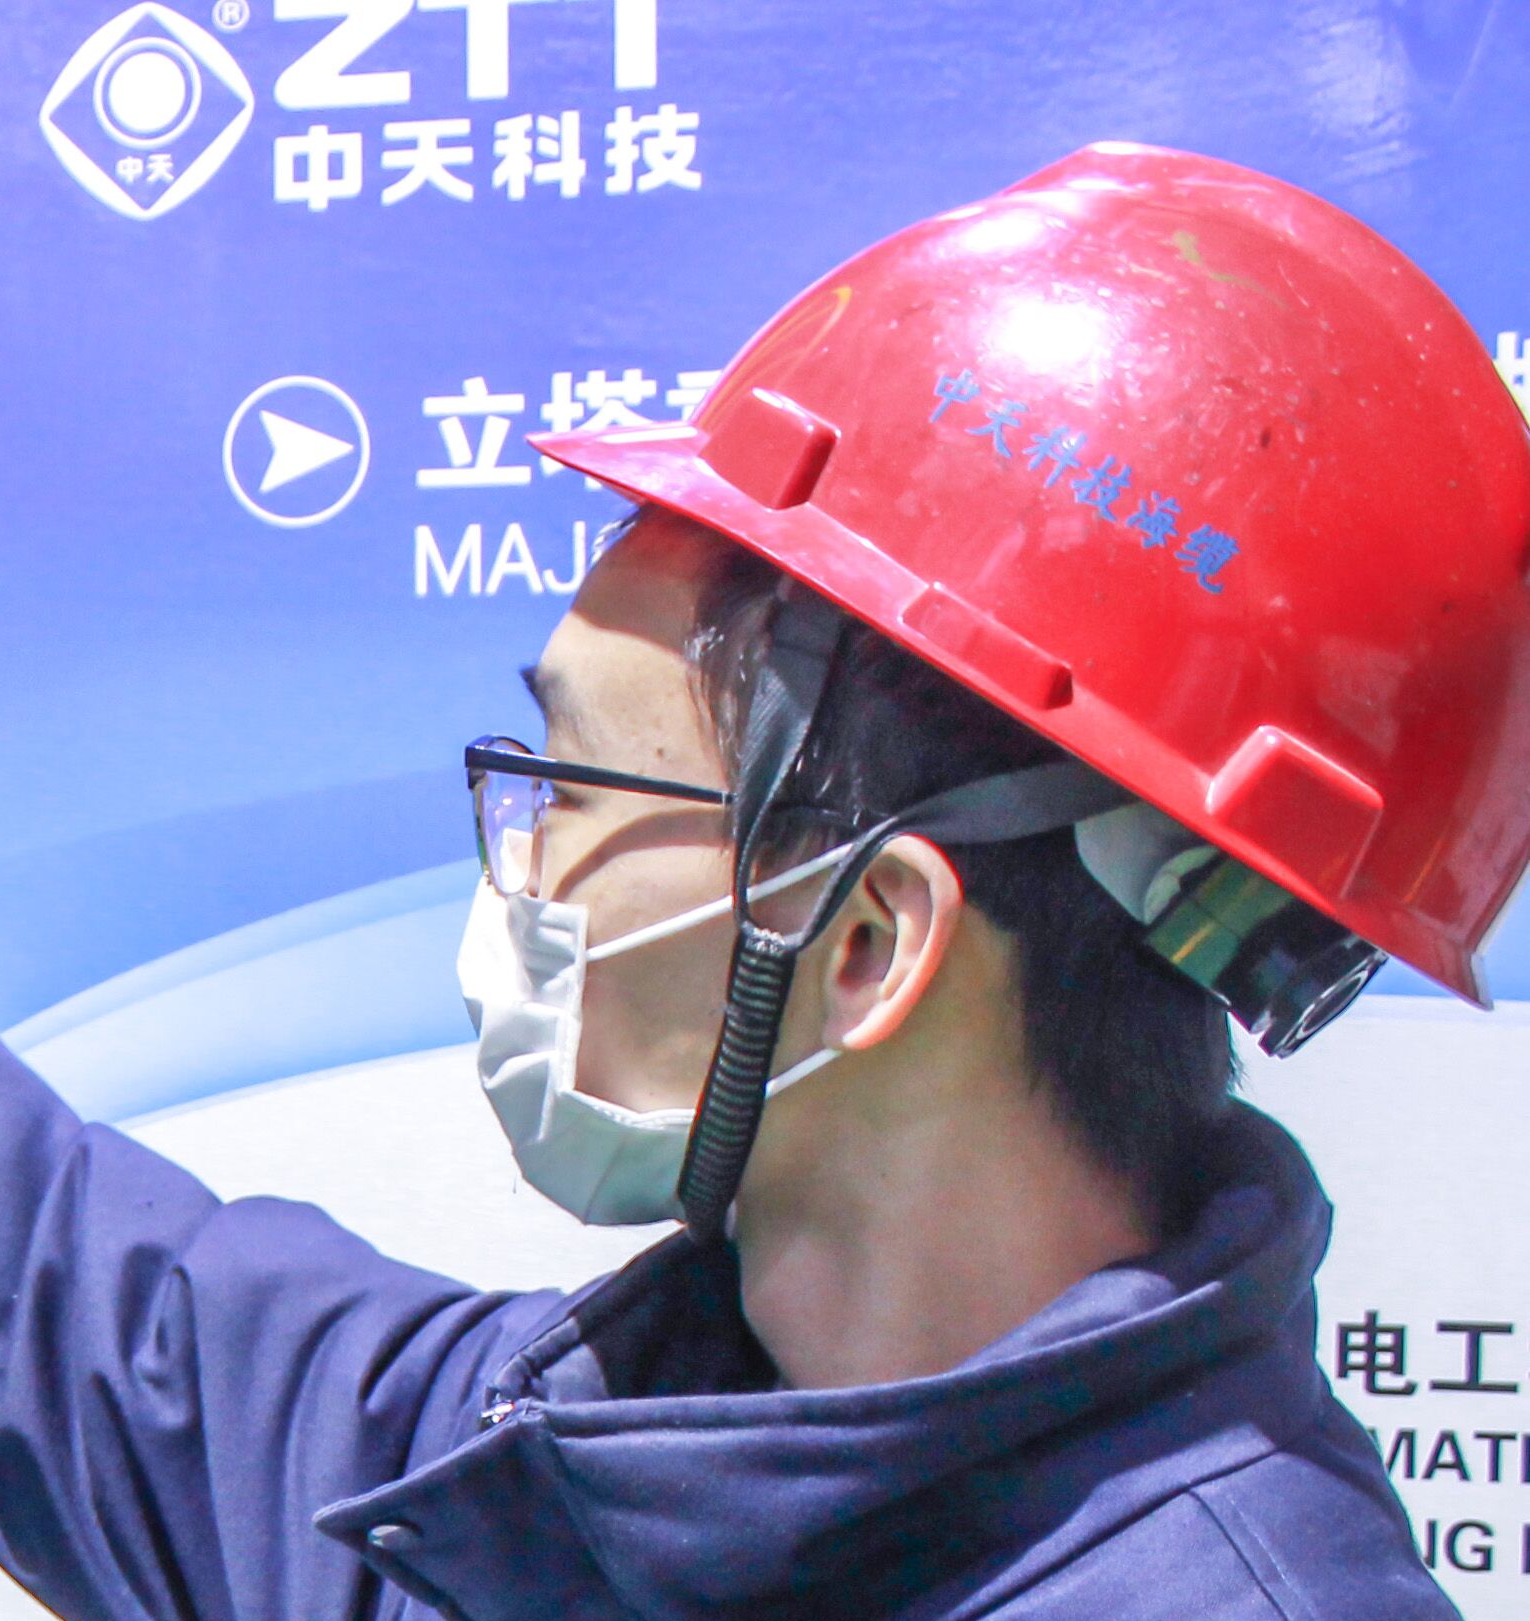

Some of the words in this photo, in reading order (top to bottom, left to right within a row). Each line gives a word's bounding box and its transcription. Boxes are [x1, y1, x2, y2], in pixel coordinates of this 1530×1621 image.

[274, 0, 659, 110] ZTT
[115, 153, 175, 186] 中天
[274, 103, 703, 212] 中天科技
[416, 368, 723, 490] 立塔
[928, 367, 1241, 594] 中天科技海缆
[1369, 1426, 1530, 1484] MAT
